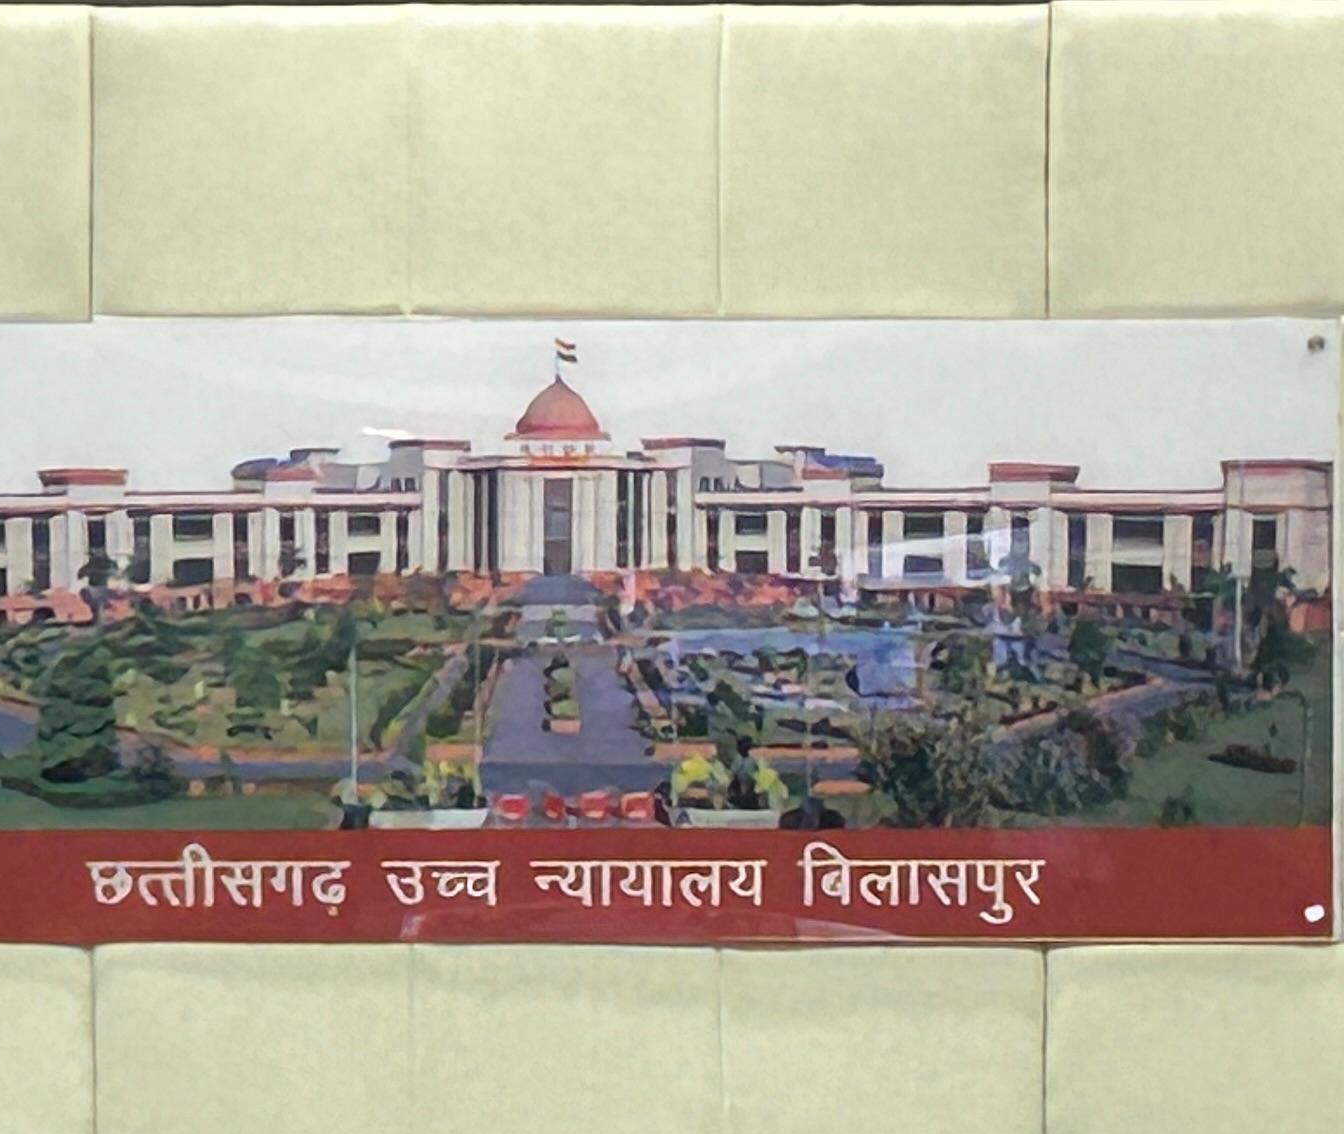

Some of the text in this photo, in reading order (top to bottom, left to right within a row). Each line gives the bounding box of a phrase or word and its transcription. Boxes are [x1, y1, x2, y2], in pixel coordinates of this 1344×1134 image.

[86, 841, 1046, 925] छत्तीसगढ़ उच्च न्यायालय बिलासपुर
